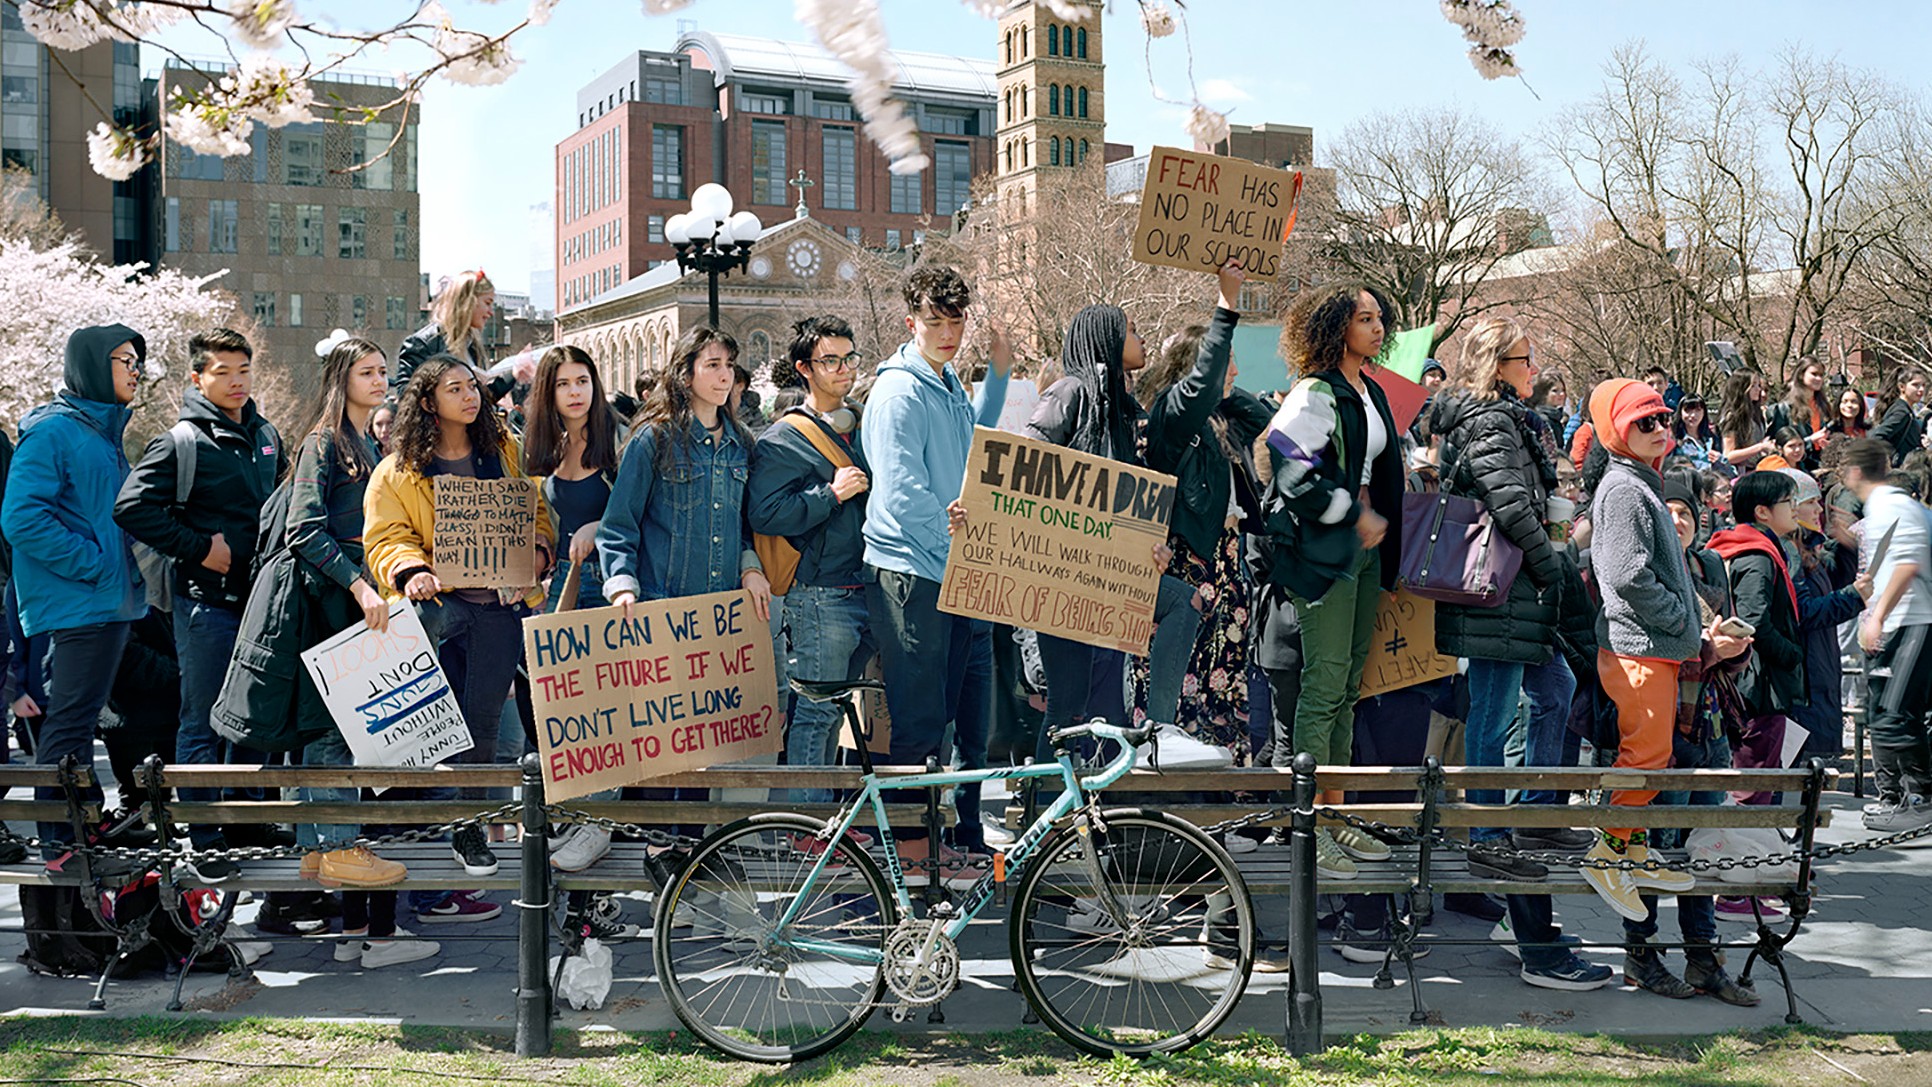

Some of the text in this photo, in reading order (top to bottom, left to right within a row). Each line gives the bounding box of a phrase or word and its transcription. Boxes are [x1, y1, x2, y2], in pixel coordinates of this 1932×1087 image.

[1159, 155, 1280, 208] FEAR HAS
[1153, 192, 1284, 243] NO PLACE IN
[1146, 228, 1279, 277] OUR SCHOOLS
[438, 480, 530, 494] WHEN I SAID
[438, 493, 528, 508] I RATHER DIE
[980, 439, 1012, 487] I
[1010, 444, 1093, 505] HAVE
[1087, 467, 1110, 514] A
[434, 521, 476, 536] CLASS,
[483, 508, 497, 520] TO
[498, 507, 535, 524] MATH
[991, 491, 1037, 519] THAT
[1039, 504, 1079, 530] ONE
[435, 534, 527, 548] MEAN IT THIS
[963, 519, 1154, 579] WE WILL WALK THROUGH
[962, 543, 1156, 606] OUR HALLWAYS AGAIN WITHOUT
[945, 564, 1017, 617] FEAR
[1020, 584, 1050, 623] OF
[1050, 591, 1115, 637] BEING
[533, 597, 745, 668] HOW CAN WE BE
[536, 643, 755, 703] THE FUTURE IF WE
[1358, 648, 1450, 691] SAFETY
[362, 674, 442, 724] GUNS
[383, 698, 454, 748] WITHOUT
[545, 685, 744, 749] DON'T LIVE LONG
[416, 713, 464, 741] PEOPLE
[421, 730, 471, 764] FUNNY
[550, 704, 773, 783] ENOUGH TO GET THERE?
